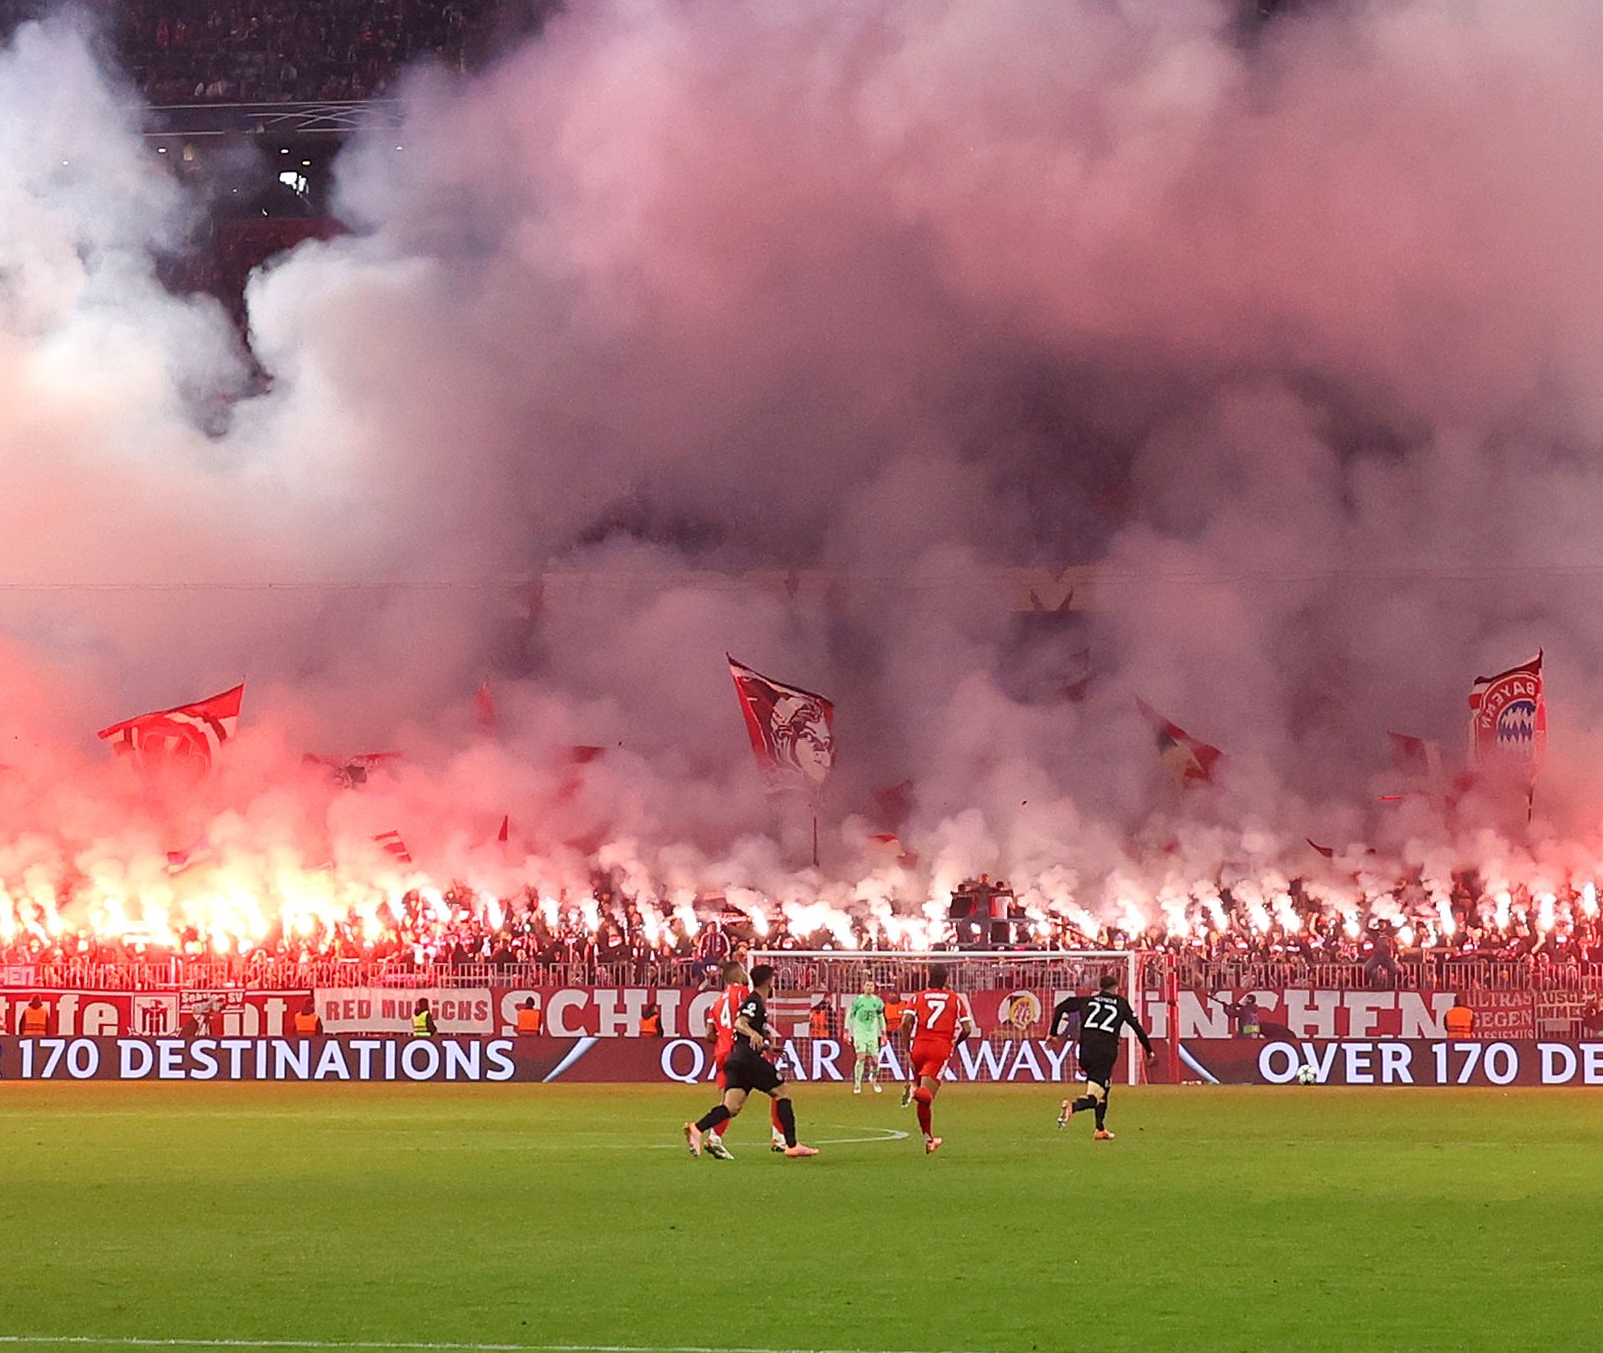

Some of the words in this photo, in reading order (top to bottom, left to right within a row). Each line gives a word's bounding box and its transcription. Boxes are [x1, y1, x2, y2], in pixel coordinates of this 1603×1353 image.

[227, 992, 244, 1003] SV
[326, 999, 372, 1021] RED
[1466, 992, 1533, 1007] ULTRAS
[719, 999, 732, 1029] 4
[927, 1000, 946, 1030] 7
[1083, 1001, 1118, 1034] 22
[1473, 1010, 1534, 1028] GEGEN
[19, 1038, 99, 1079] 170
[117, 1039, 515, 1081] DESTINATIONS
[1259, 1041, 1414, 1085] OVER
[1431, 1041, 1519, 1085] 170
